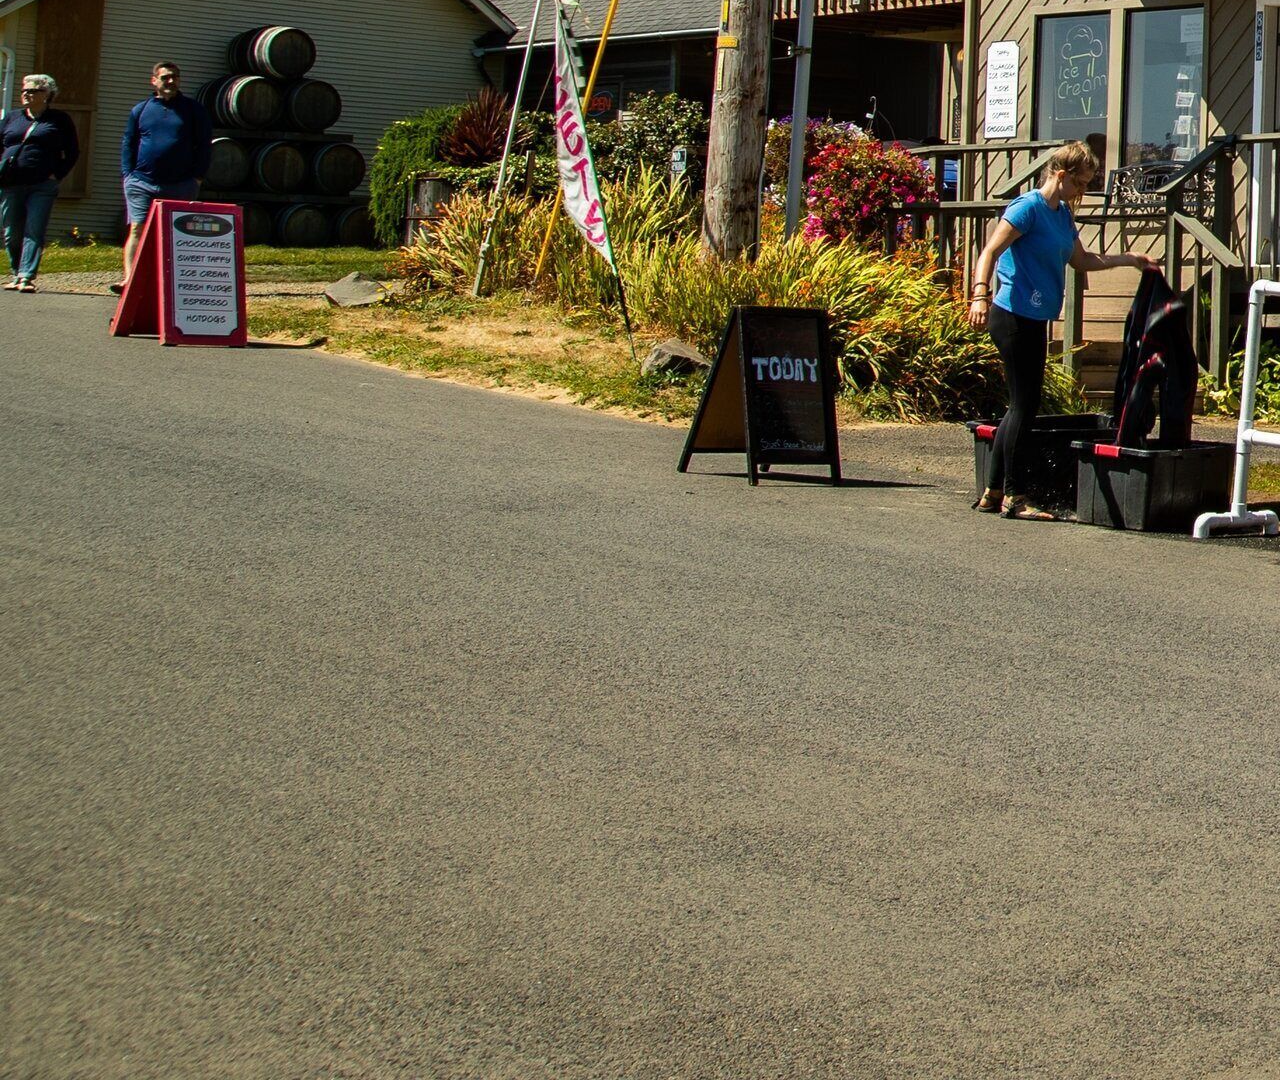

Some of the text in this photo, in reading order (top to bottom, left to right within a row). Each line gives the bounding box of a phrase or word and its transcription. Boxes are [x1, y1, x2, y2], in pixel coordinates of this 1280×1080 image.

[1059, 66, 1080, 80] Ice
[1058, 74, 1107, 99] Cream
[176, 239, 232, 249] CHOCOLATES
[177, 254, 232, 264] SWEET TAFFY
[180, 269, 230, 278] ICE CREAM
[178, 283, 232, 293] FRESH FUDGE
[183, 298, 228, 307] ESPRESSO
[186, 315, 226, 324] HOTDOGS
[752, 356, 818, 383] TODAY
